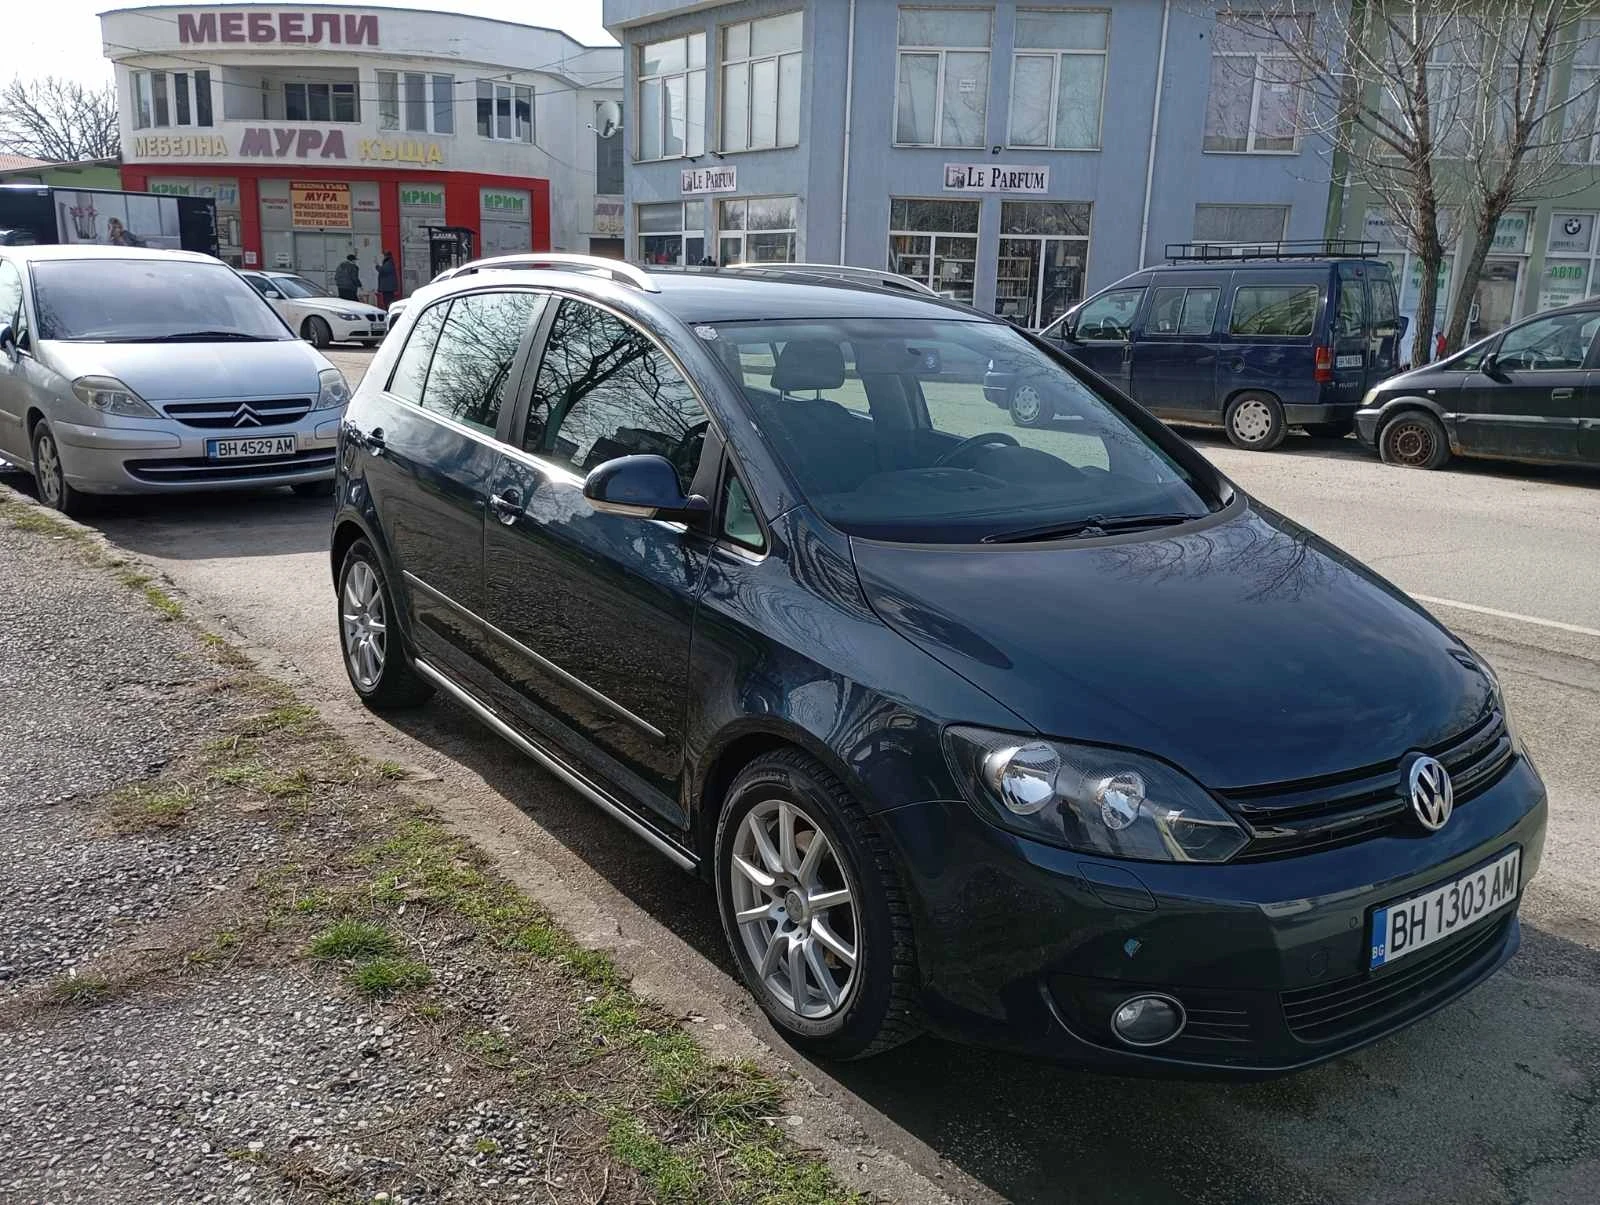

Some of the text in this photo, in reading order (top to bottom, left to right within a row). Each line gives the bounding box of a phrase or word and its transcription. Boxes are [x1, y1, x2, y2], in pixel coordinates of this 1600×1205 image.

[177, 13, 379, 46] МЕБЕЛИ
[134, 127, 443, 166] МЕБЕЛНА МУРА КЪЩА
[304, 191, 337, 202] МУРА
[1551, 265, 1584, 280] АВТО
[218, 438, 293, 456] BH 4529 AM
[1390, 856, 1517, 954] BH 1303 AM
[1371, 944, 1385, 959] BG
